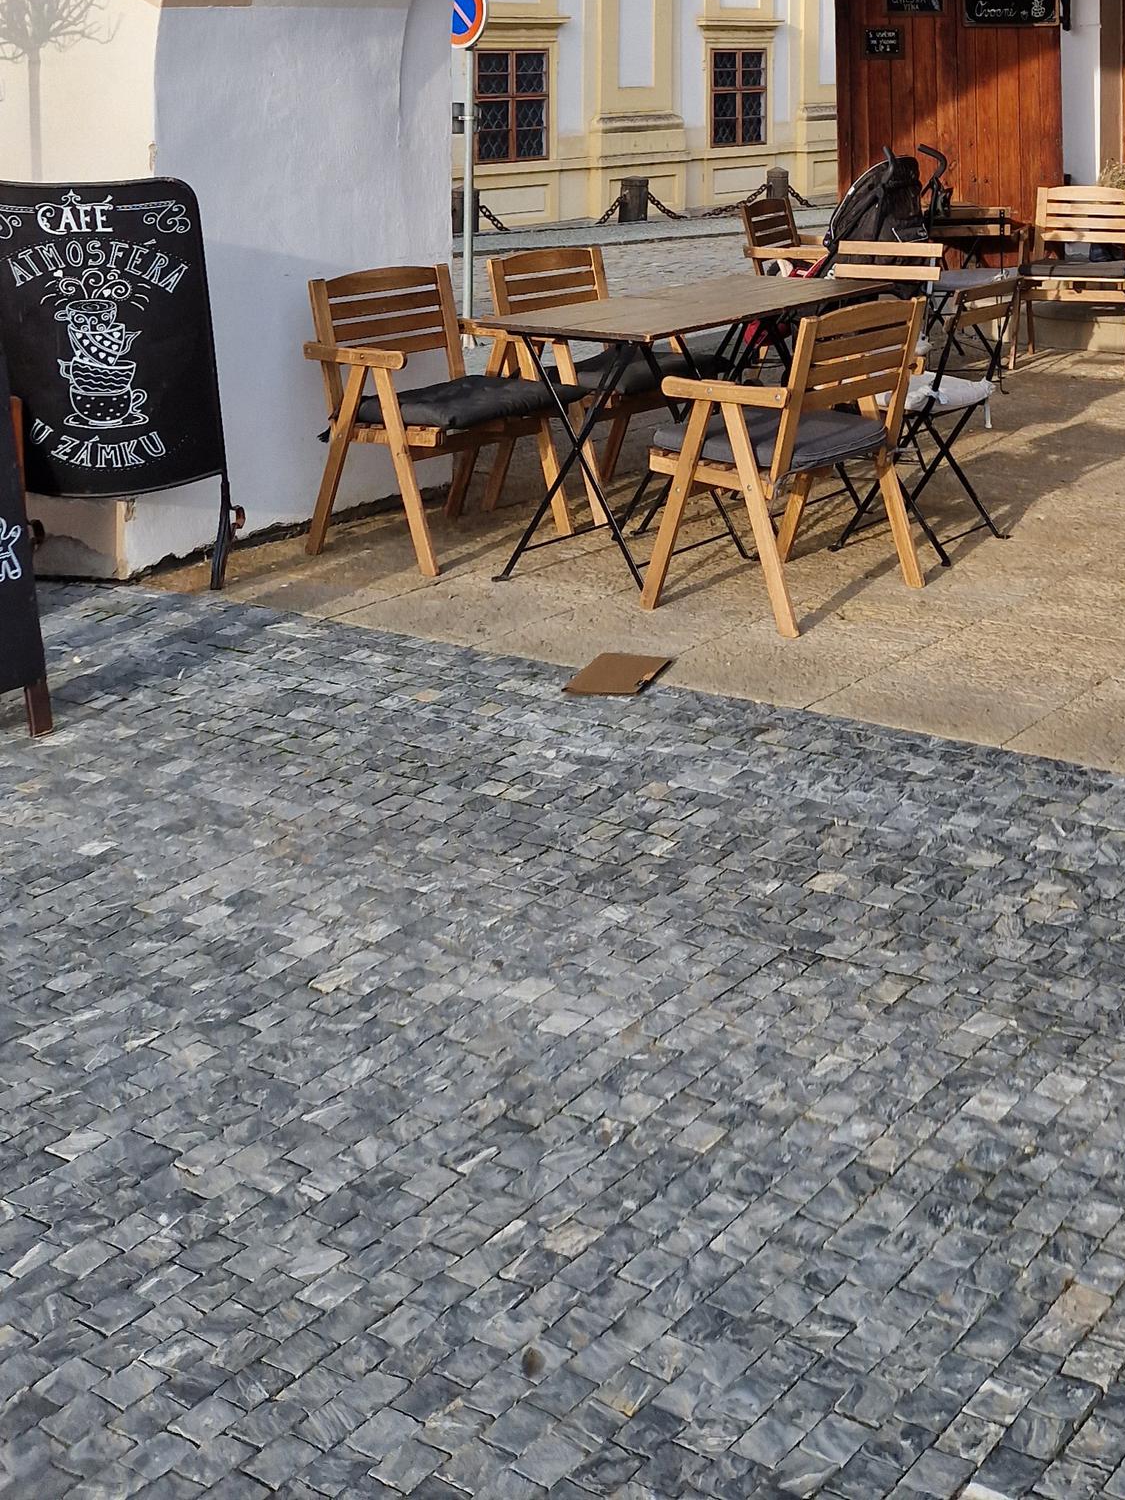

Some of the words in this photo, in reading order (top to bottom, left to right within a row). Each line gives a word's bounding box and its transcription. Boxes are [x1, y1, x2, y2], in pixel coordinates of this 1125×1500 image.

[36, 194, 114, 236] CAFÉ
[7, 238, 189, 294] ATMOSFÉRA
[30, 418, 54, 445] U
[51, 430, 167, 468] ZÁMKU
